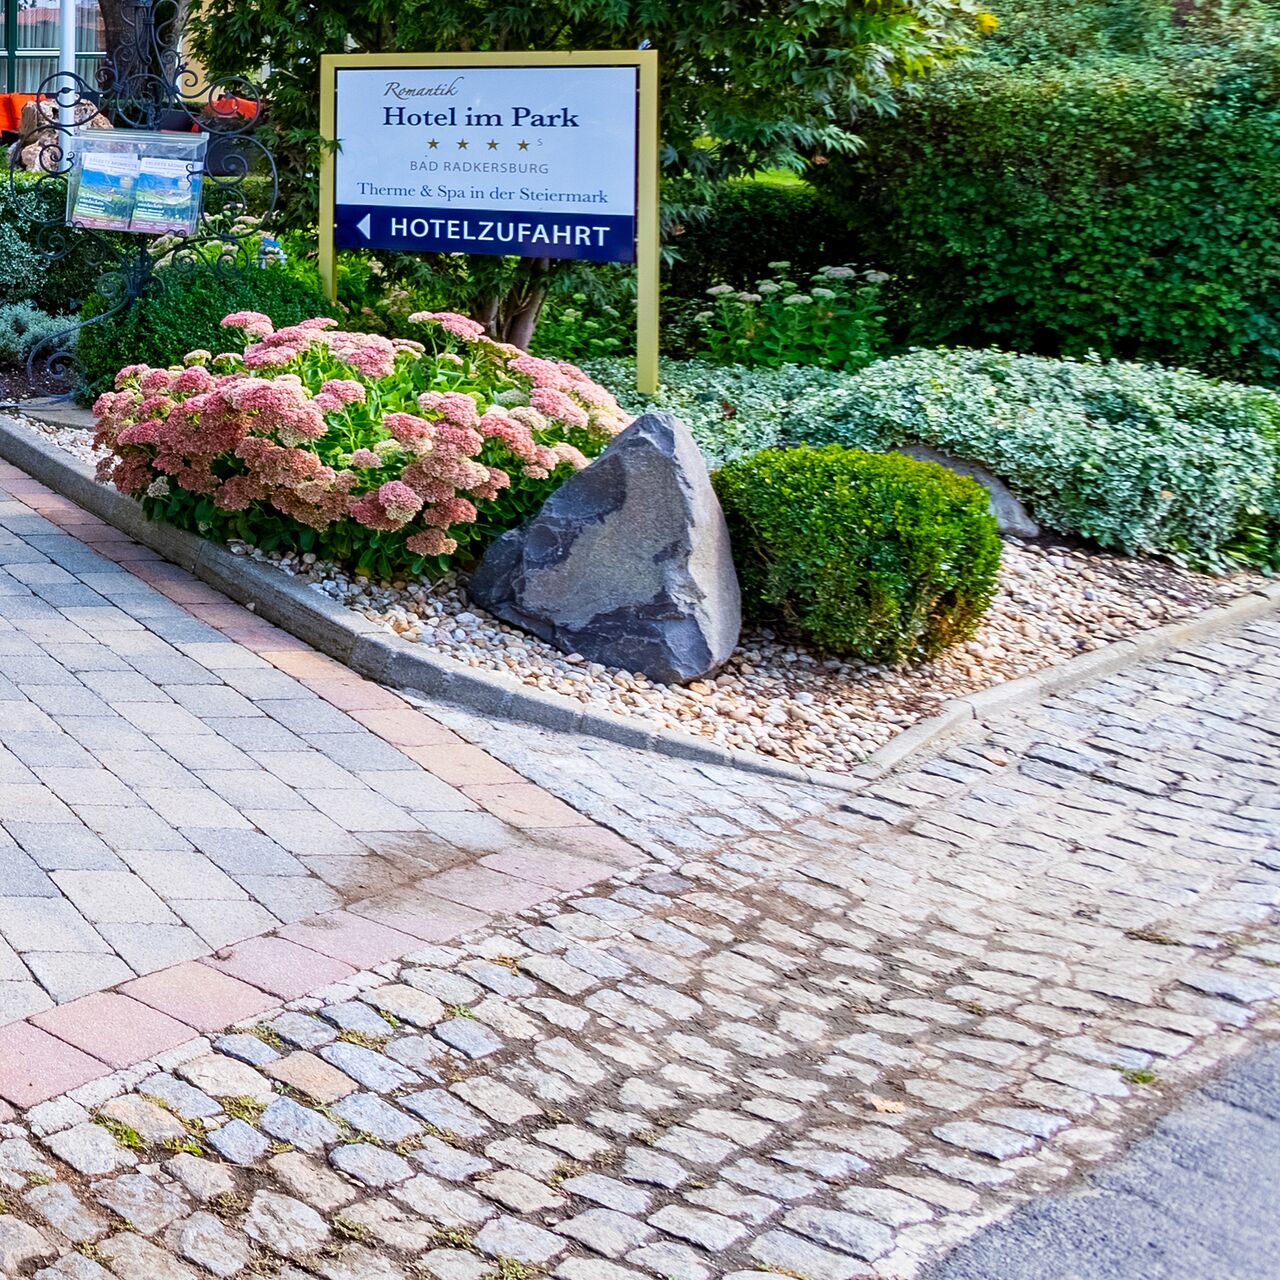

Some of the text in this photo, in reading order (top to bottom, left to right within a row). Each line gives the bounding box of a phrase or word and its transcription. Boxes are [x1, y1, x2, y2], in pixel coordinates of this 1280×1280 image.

[384, 76, 465, 100] Romantik
[383, 106, 580, 128] Hotel im Park
[410, 160, 549, 175] BAD RADKERSBURG
[357, 182, 609, 204] Therme & Spa in der Steiermark
[391, 217, 610, 246] HOTELZUFAHRT
